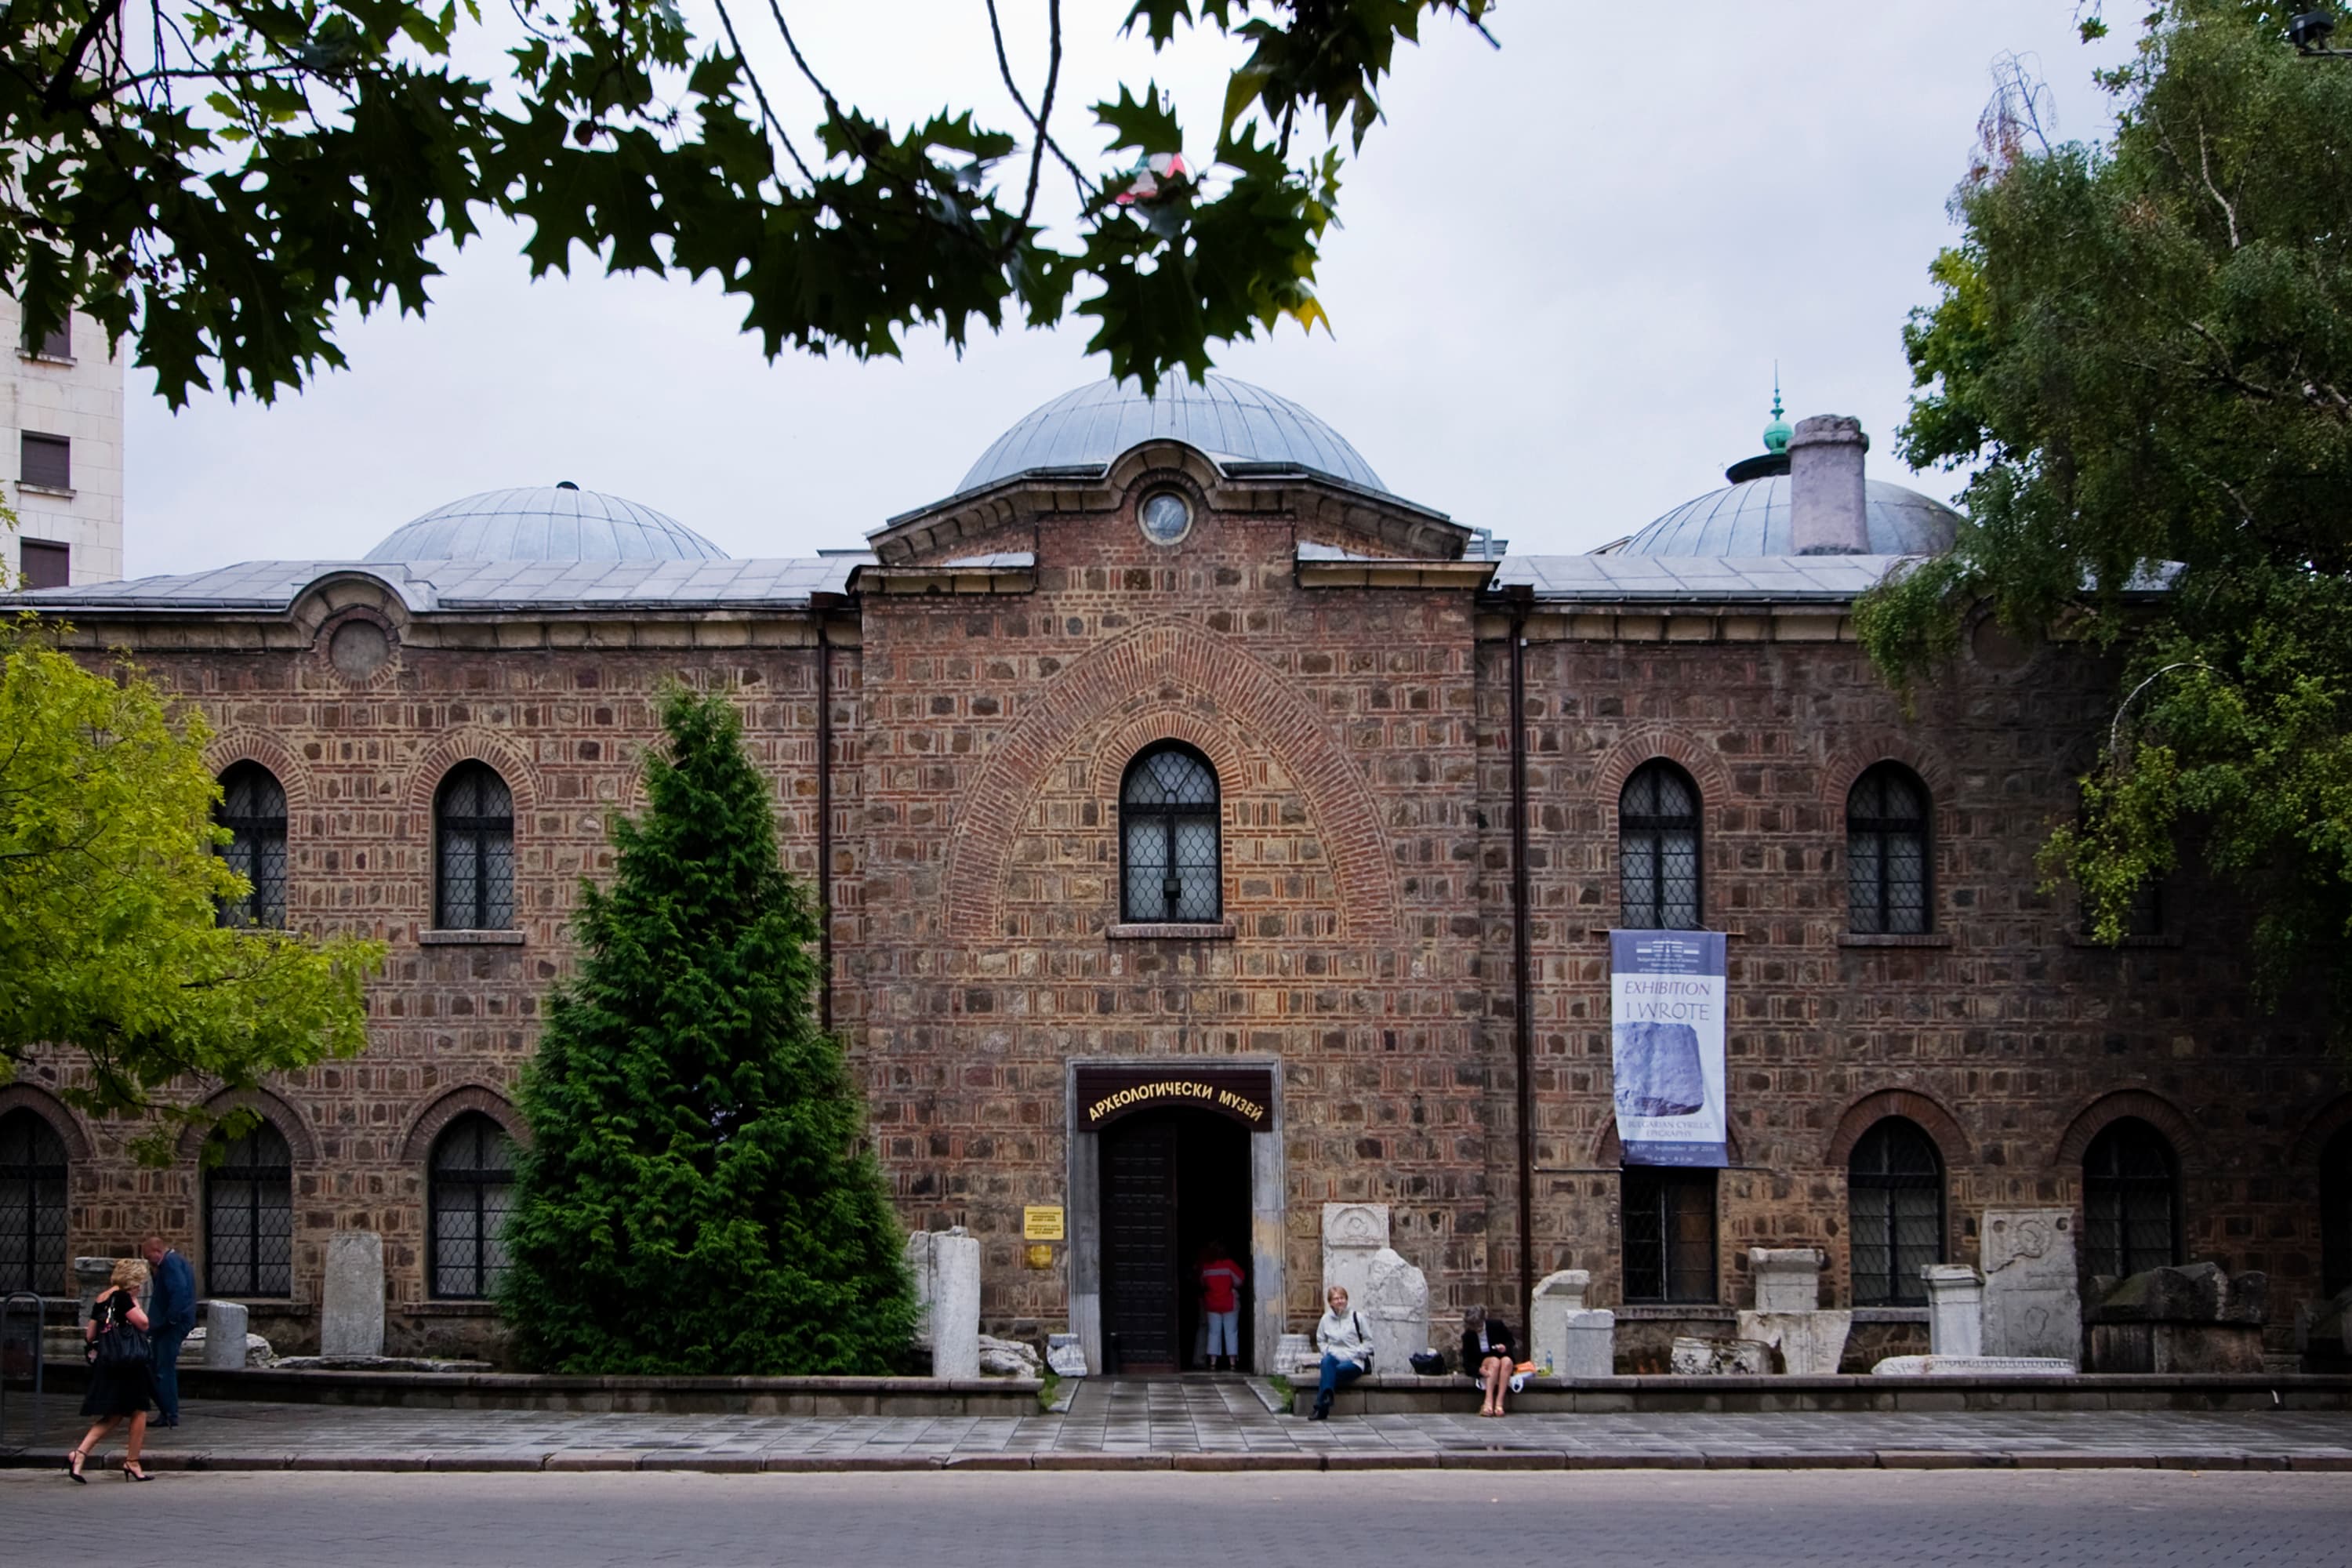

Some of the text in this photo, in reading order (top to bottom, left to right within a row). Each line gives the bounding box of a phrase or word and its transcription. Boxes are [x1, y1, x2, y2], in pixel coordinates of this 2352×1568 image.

[1624, 981, 1711, 996] EXHIBITION
[1626, 1002, 1711, 1020] I WROTE
[1088, 1082, 1264, 1122] АРХЕОЛОГИЧЕСКИ МУЗЕЙ
